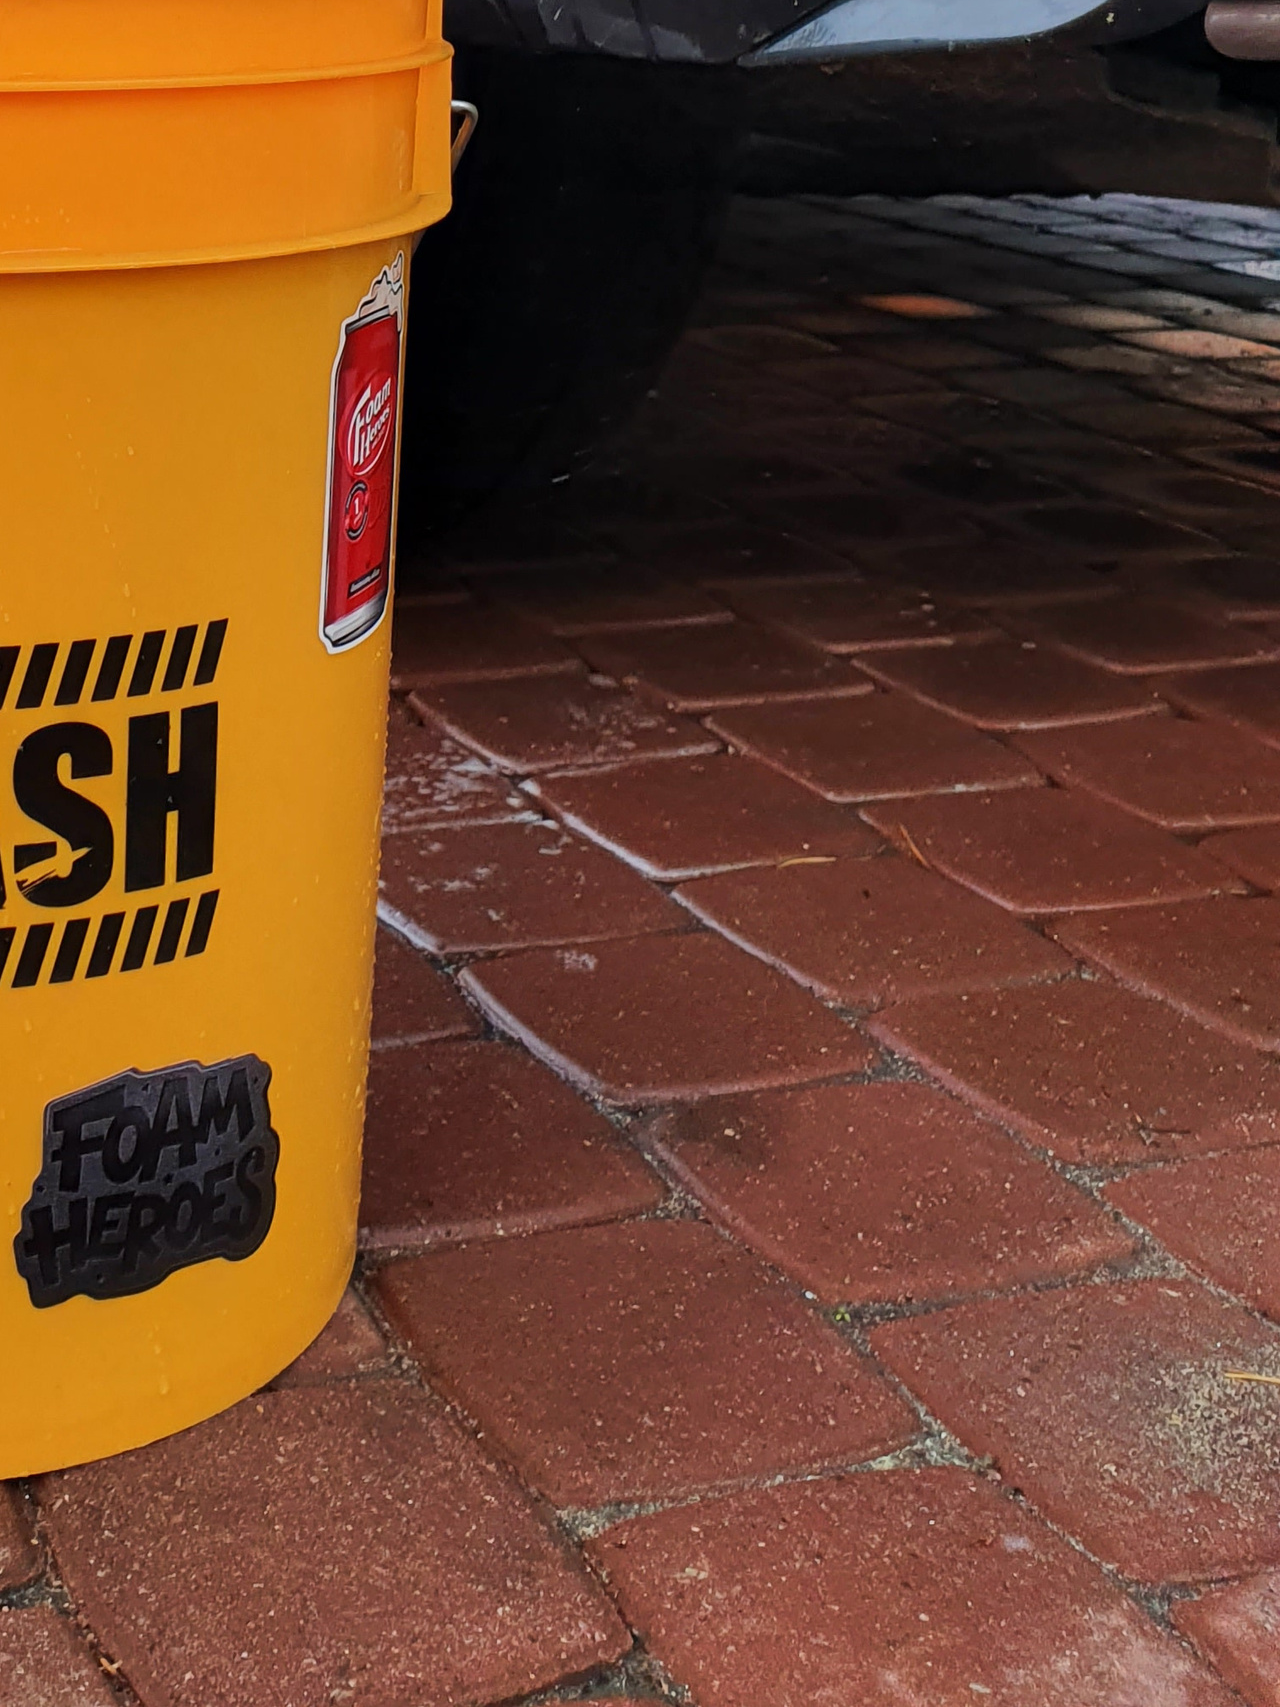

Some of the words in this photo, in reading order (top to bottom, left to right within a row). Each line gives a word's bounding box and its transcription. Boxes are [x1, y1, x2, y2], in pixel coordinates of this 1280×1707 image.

[349, 377, 391, 467] Foam
[52, 1068, 254, 1192] FOAM
[24, 1146, 266, 1286] HEROES
